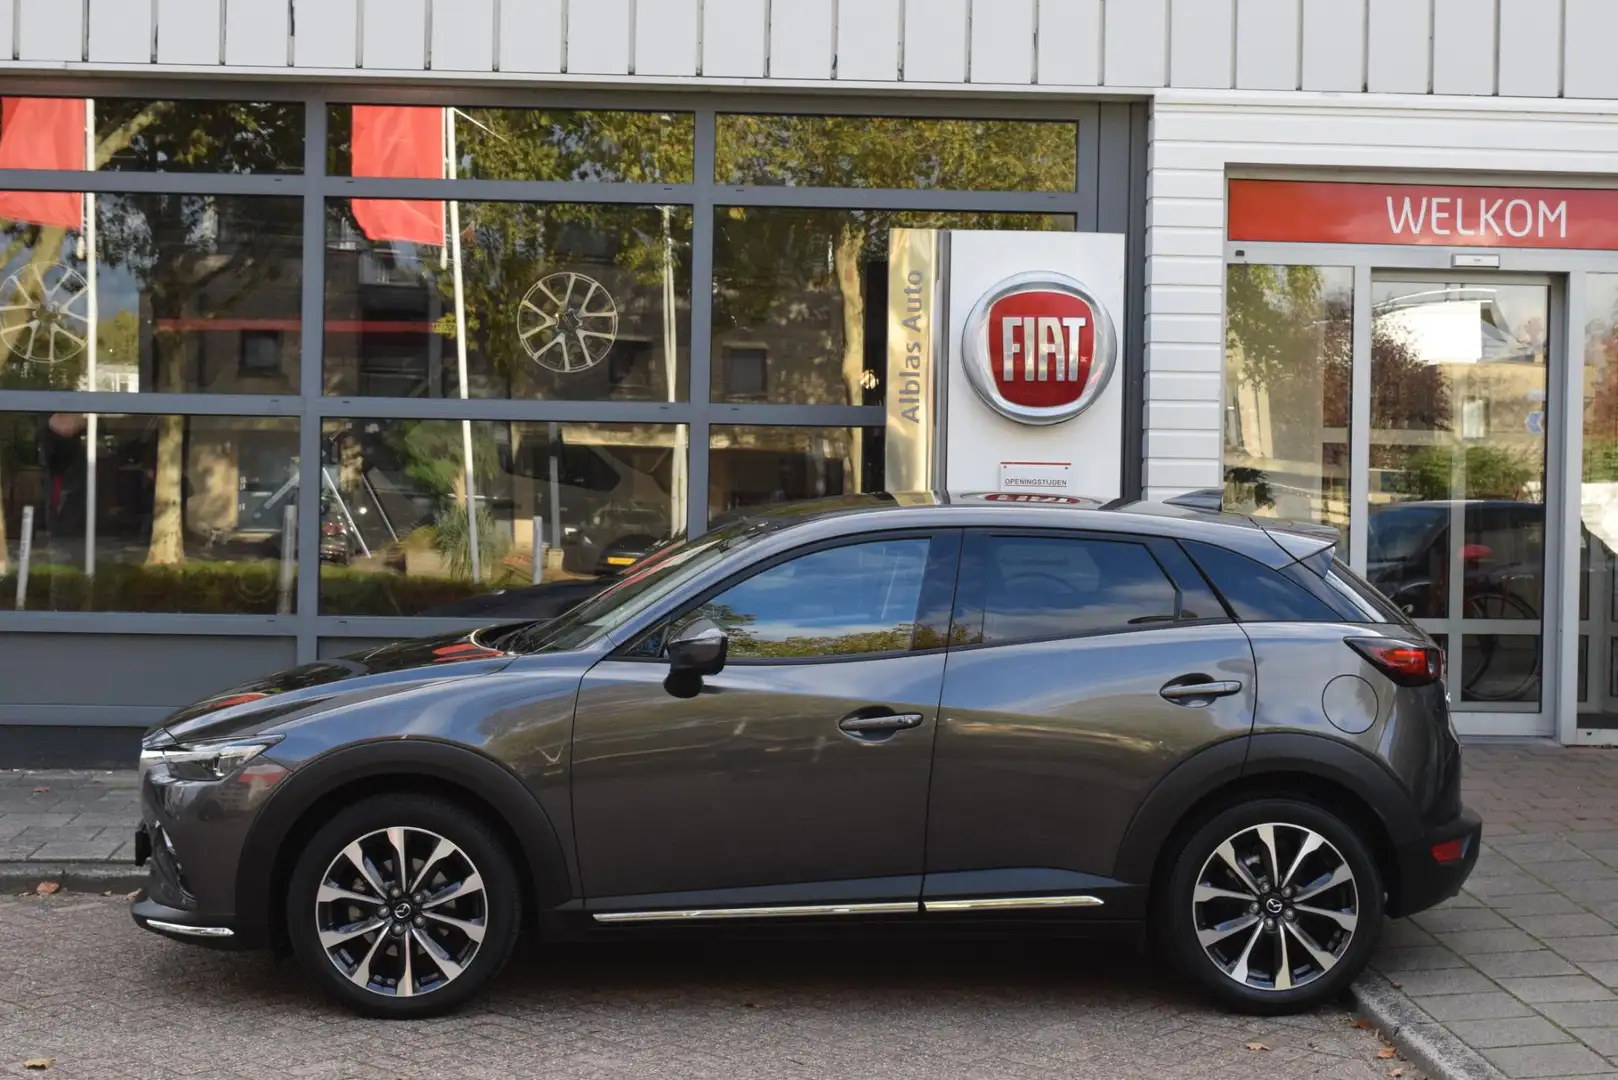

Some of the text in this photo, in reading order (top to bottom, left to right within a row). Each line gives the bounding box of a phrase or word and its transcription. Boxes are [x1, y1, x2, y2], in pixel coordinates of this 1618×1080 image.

[1386, 196, 1568, 239] WELKOM
[899, 270, 923, 424] Alblas Auto
[1002, 317, 1087, 382] FIAT
[1004, 478, 1067, 486] OPENINGSTIJDEN
